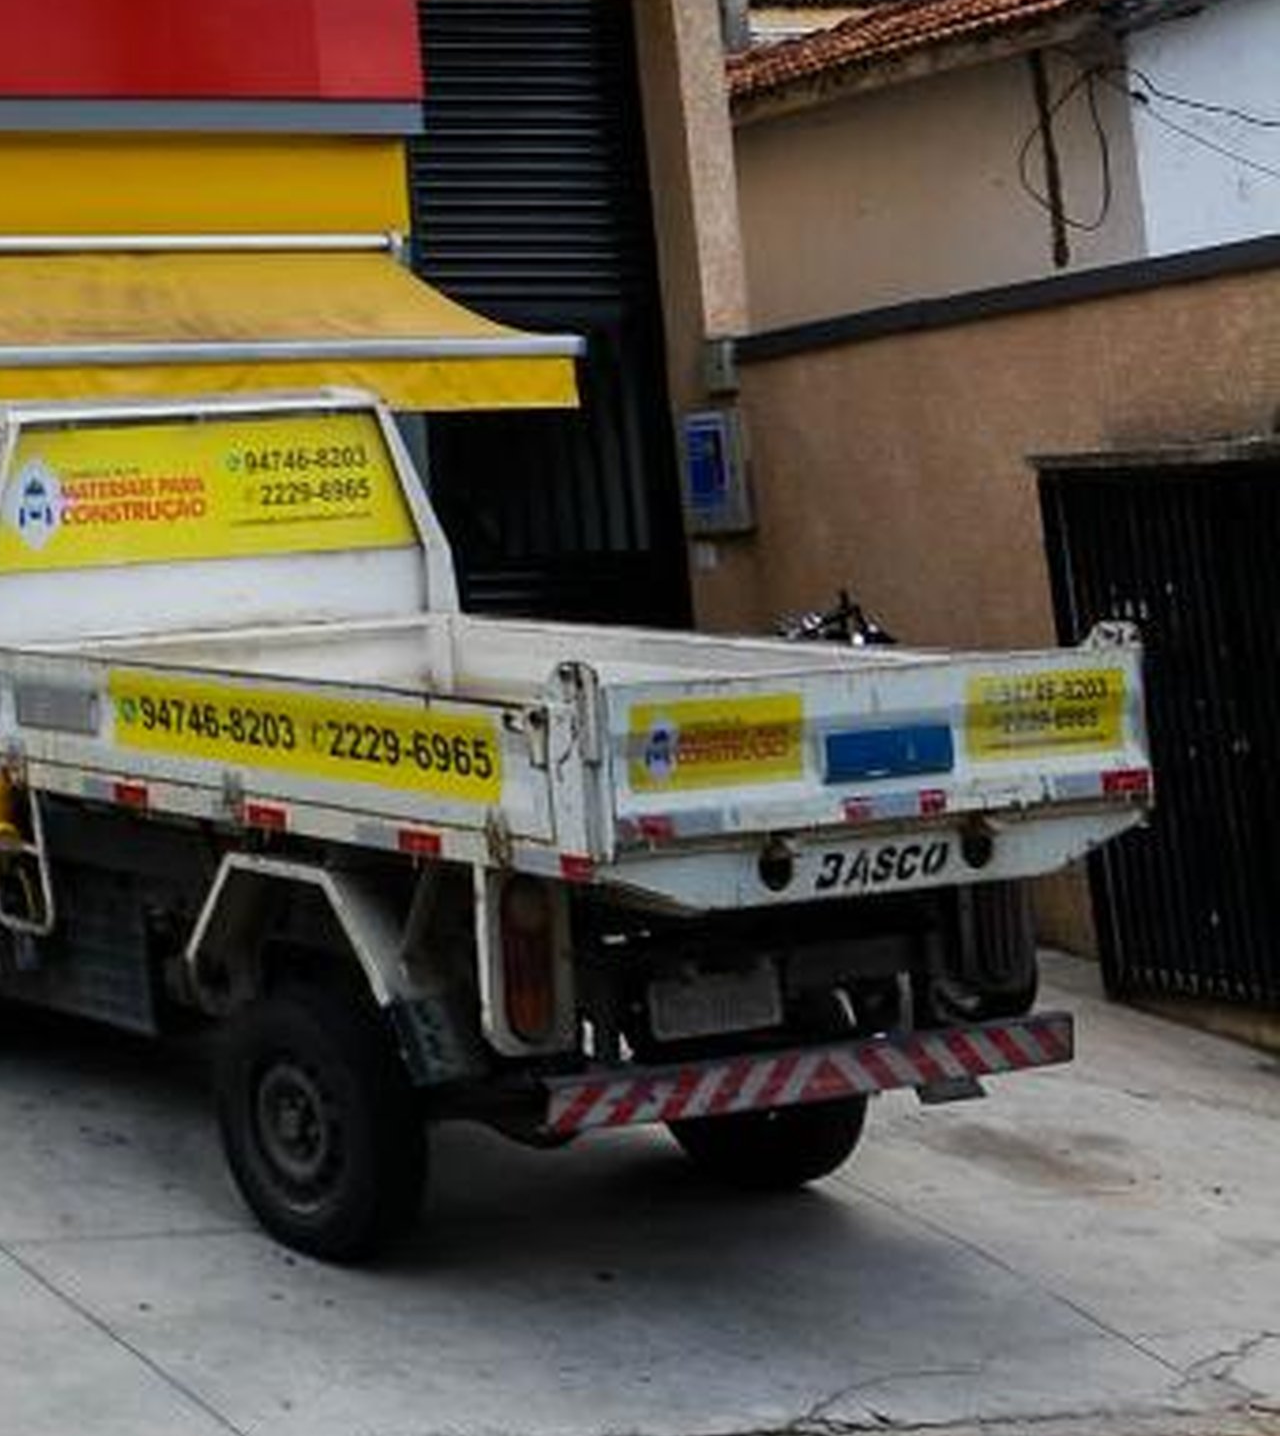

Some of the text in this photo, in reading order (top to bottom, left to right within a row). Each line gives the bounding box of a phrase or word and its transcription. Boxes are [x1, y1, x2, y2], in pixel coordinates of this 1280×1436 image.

[244, 444, 368, 474] 94746-8203
[59, 477, 155, 500] MATERIAIS
[259, 477, 372, 507] 2229-6965
[59, 496, 207, 527] CONSTRUÇÃO
[139, 696, 494, 781] 94746-8203 2229-6965
